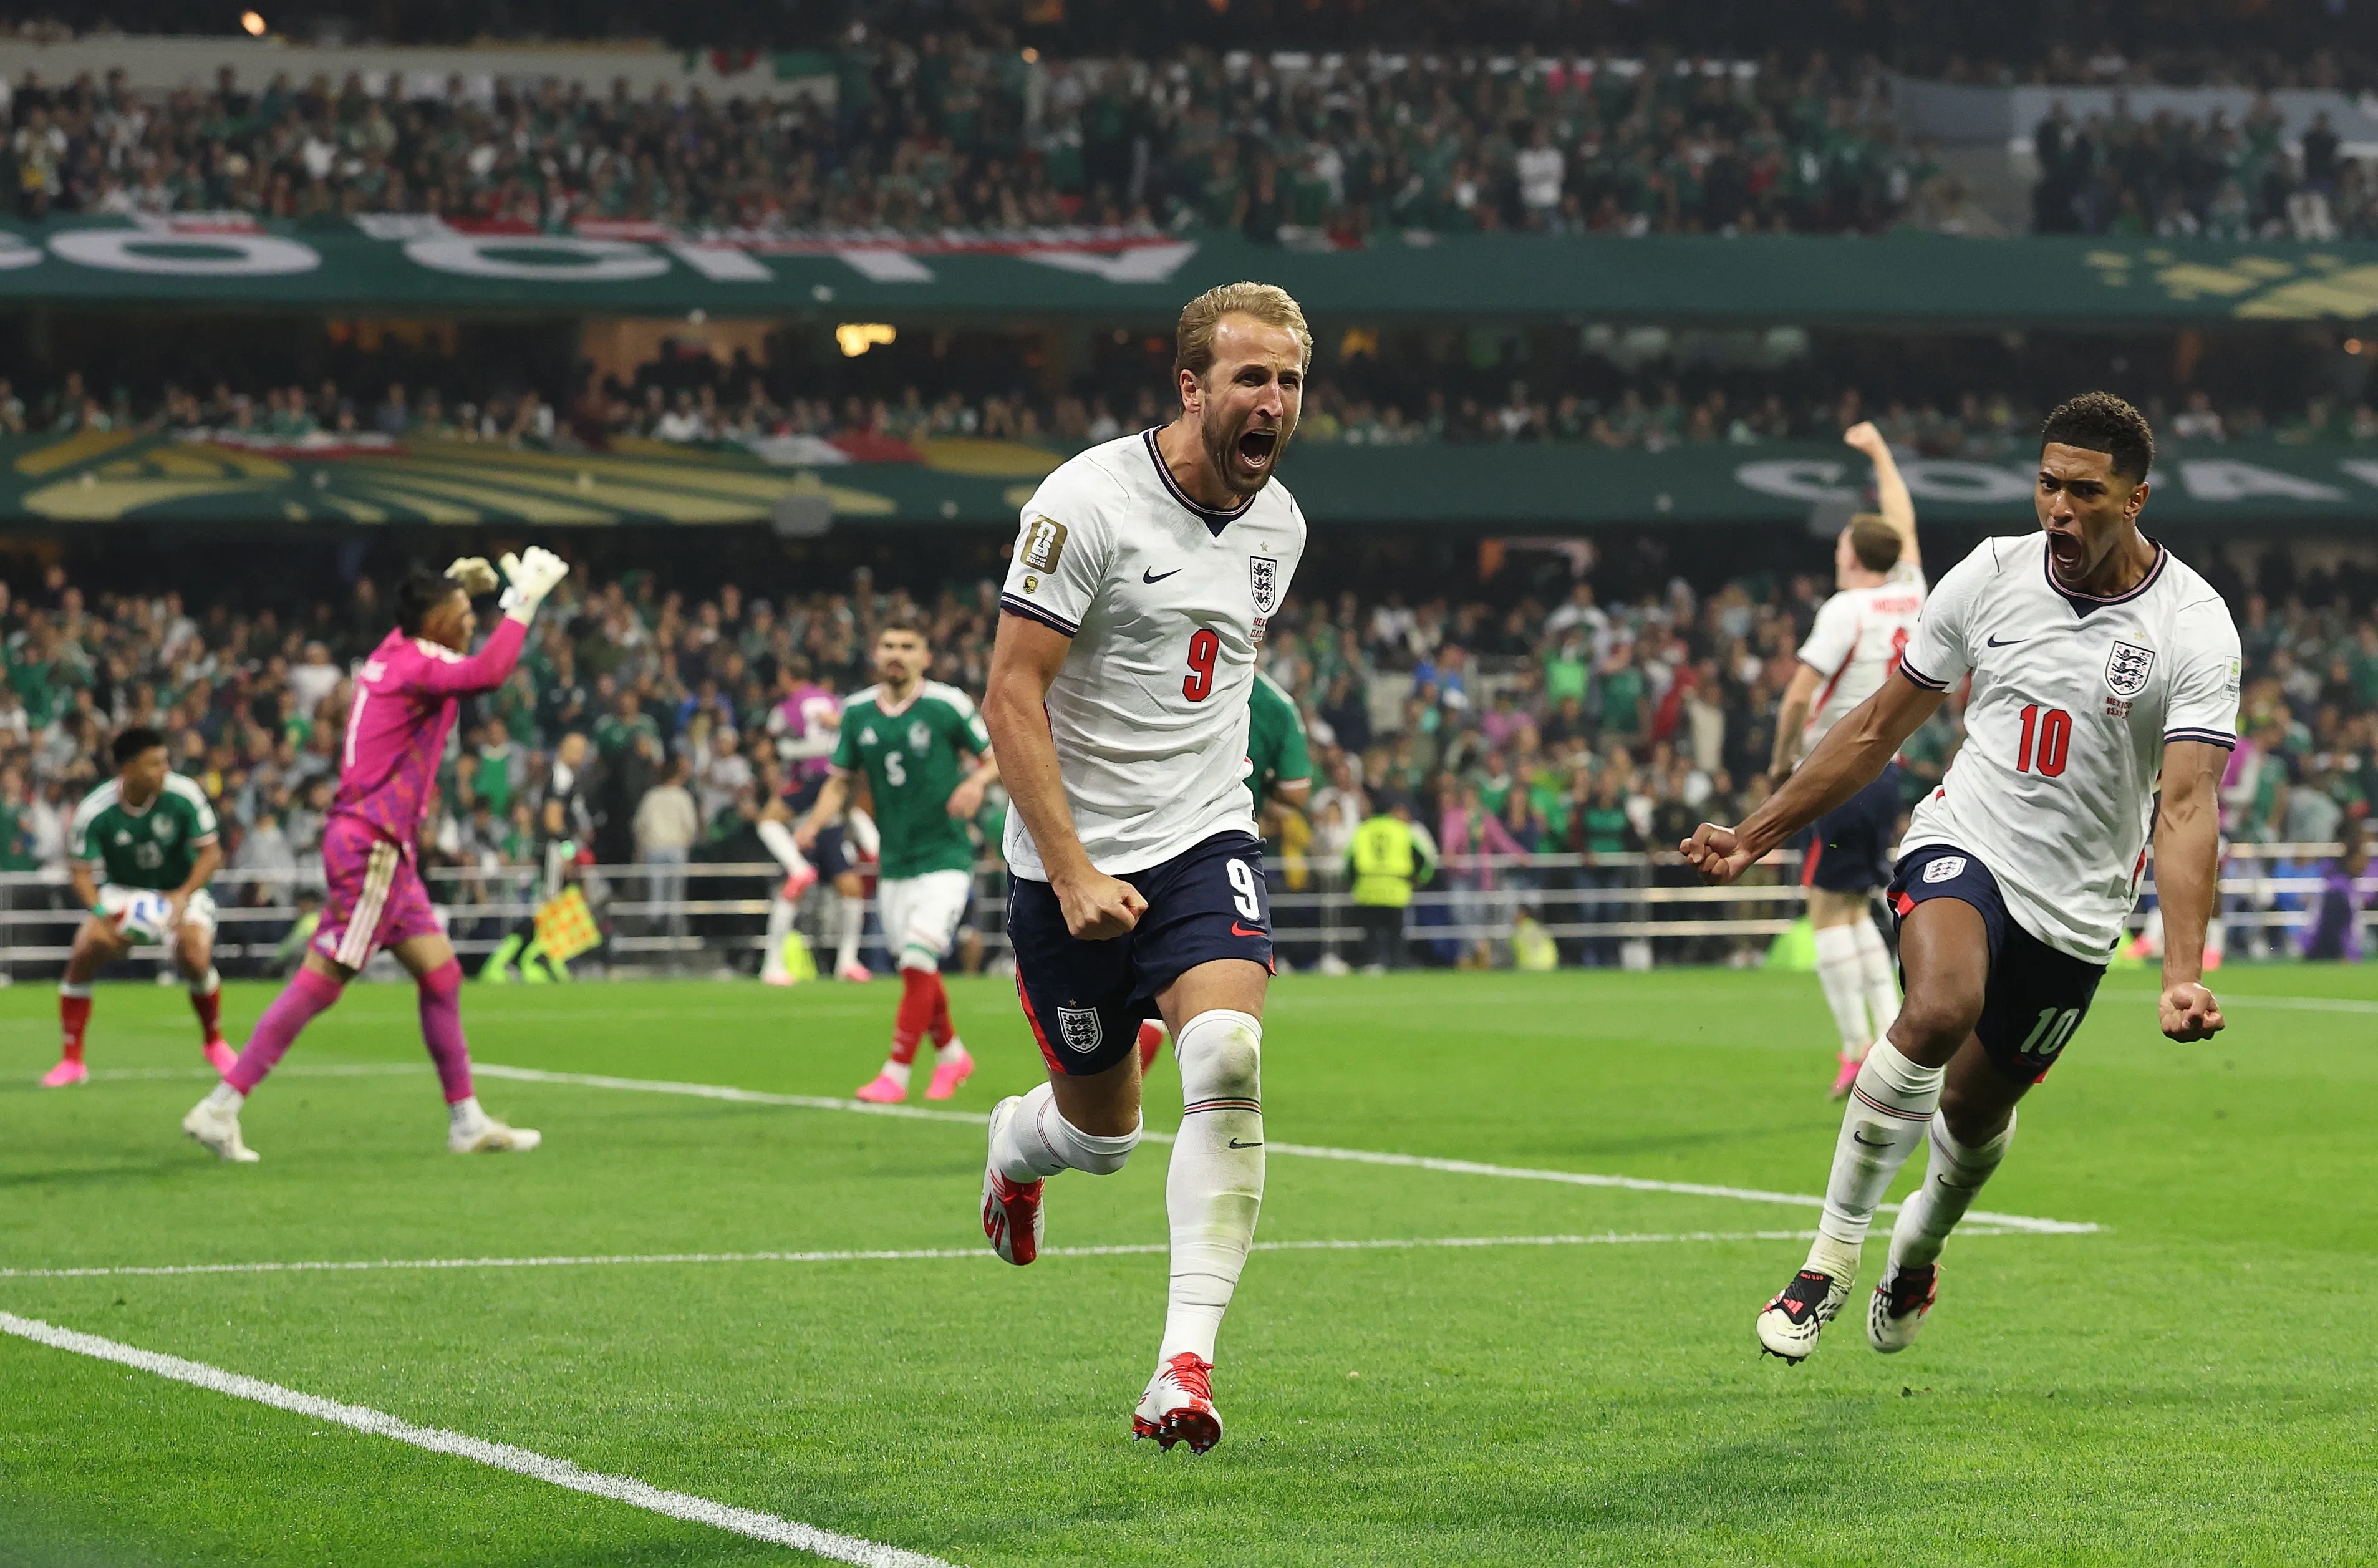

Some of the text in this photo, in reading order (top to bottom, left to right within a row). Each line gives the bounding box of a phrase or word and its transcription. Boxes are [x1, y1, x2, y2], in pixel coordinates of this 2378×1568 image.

[0, 228, 322, 275] O
[1734, 458, 2349, 501] COA
[1026, 556, 1045, 568] 2026
[1182, 629, 1219, 702] 9
[2106, 697, 2133, 709] MEXICO
[2017, 704, 2072, 777] 10
[884, 750, 906, 786] 5
[1226, 858, 1260, 921] 9
[2021, 1007, 2080, 1055] 10
